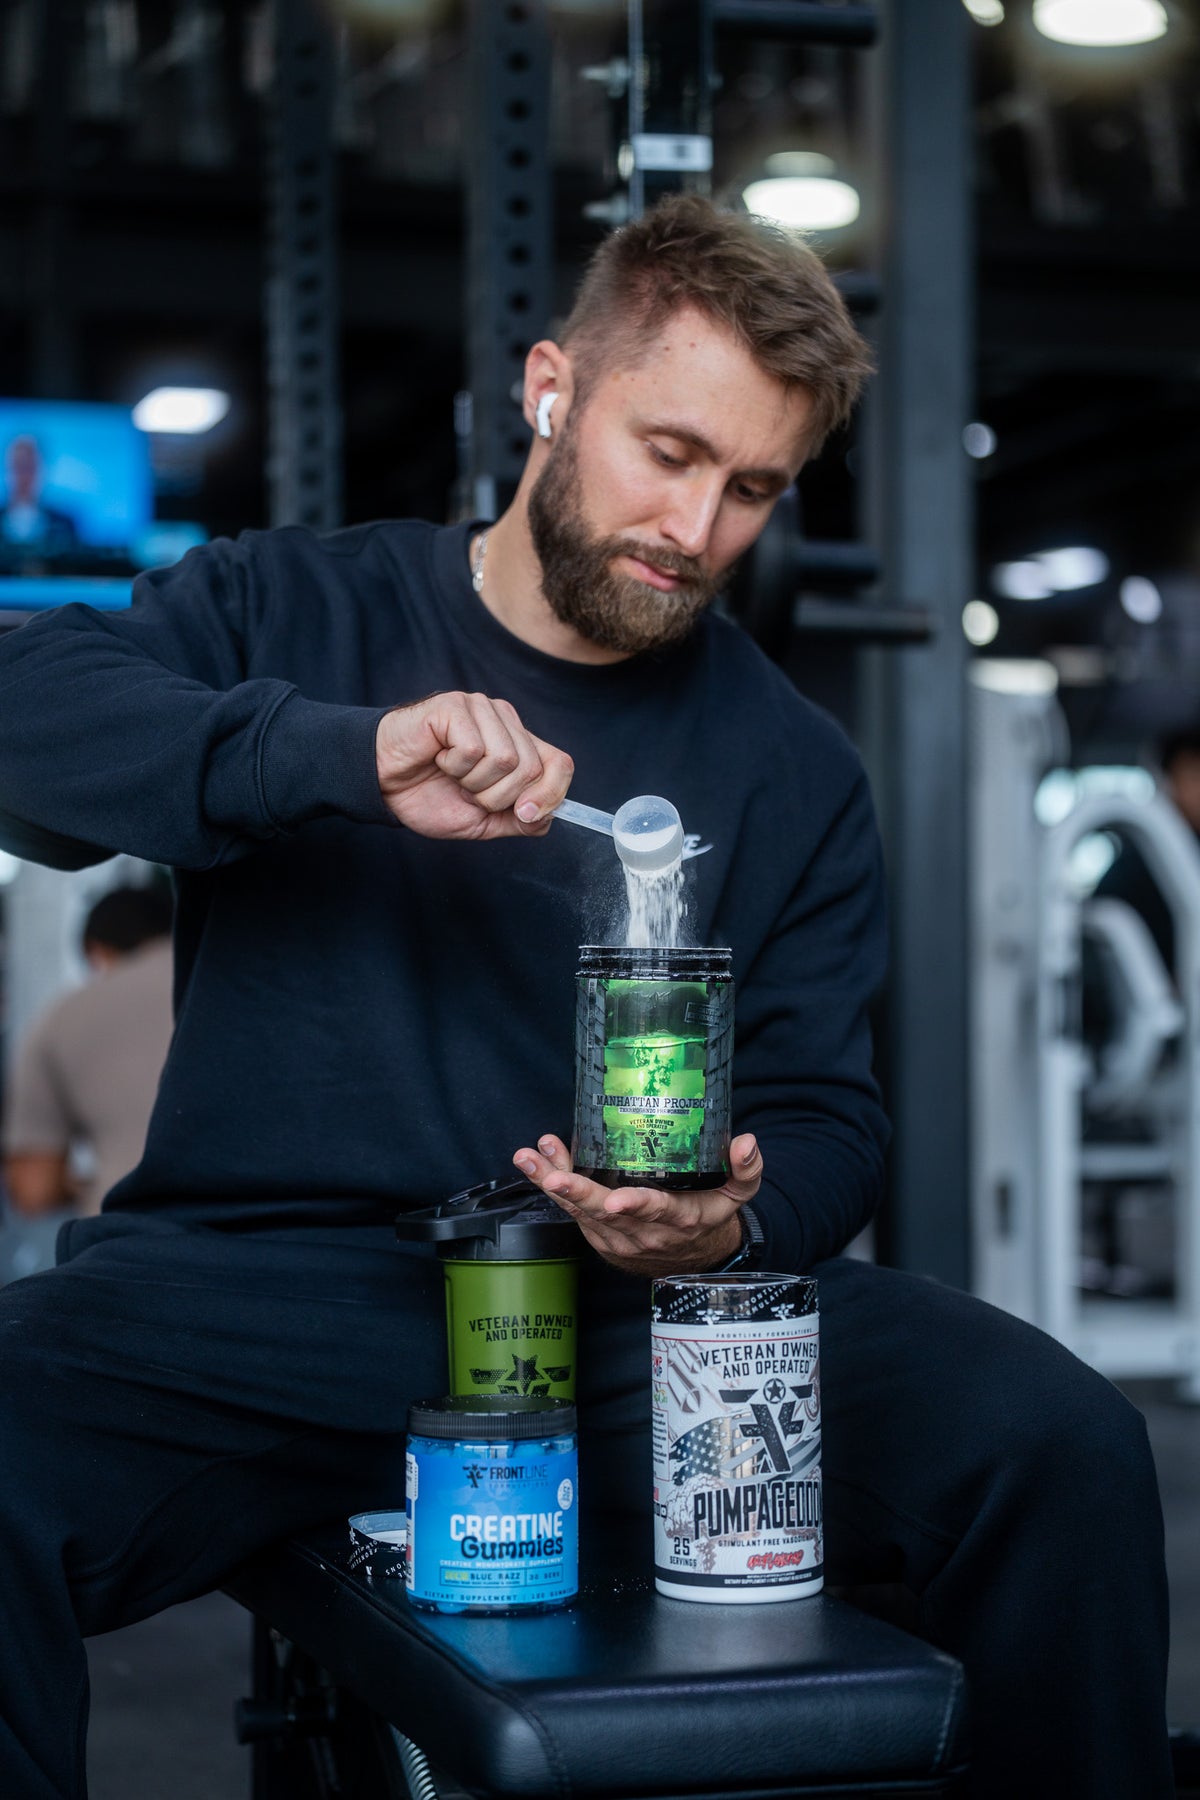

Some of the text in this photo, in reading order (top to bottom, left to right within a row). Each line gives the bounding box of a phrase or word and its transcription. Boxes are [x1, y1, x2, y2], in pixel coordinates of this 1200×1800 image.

[597, 1094, 710, 1109] MANHATTAN PROJECT
[468, 1314, 574, 1333] VETERAN OWNED
[485, 1327, 563, 1343] AND OPERATED
[766, 1328, 813, 1337] FORMULATIONS
[700, 1342, 818, 1367] VETERAN OWNED
[722, 1359, 810, 1379] AND OPERATED
[490, 1464, 549, 1480] FRONTLINE
[450, 1511, 563, 1541] CREATINE
[461, 1534, 564, 1560] Gummies
[673, 1536, 690, 1556] 25
[718, 1539, 761, 1547] STIMULANT
[763, 1538, 780, 1546] FREE
[669, 1555, 697, 1567] SERVINGS
[470, 1572, 493, 1580] BLUE
[498, 1572, 520, 1581] RAZZ
